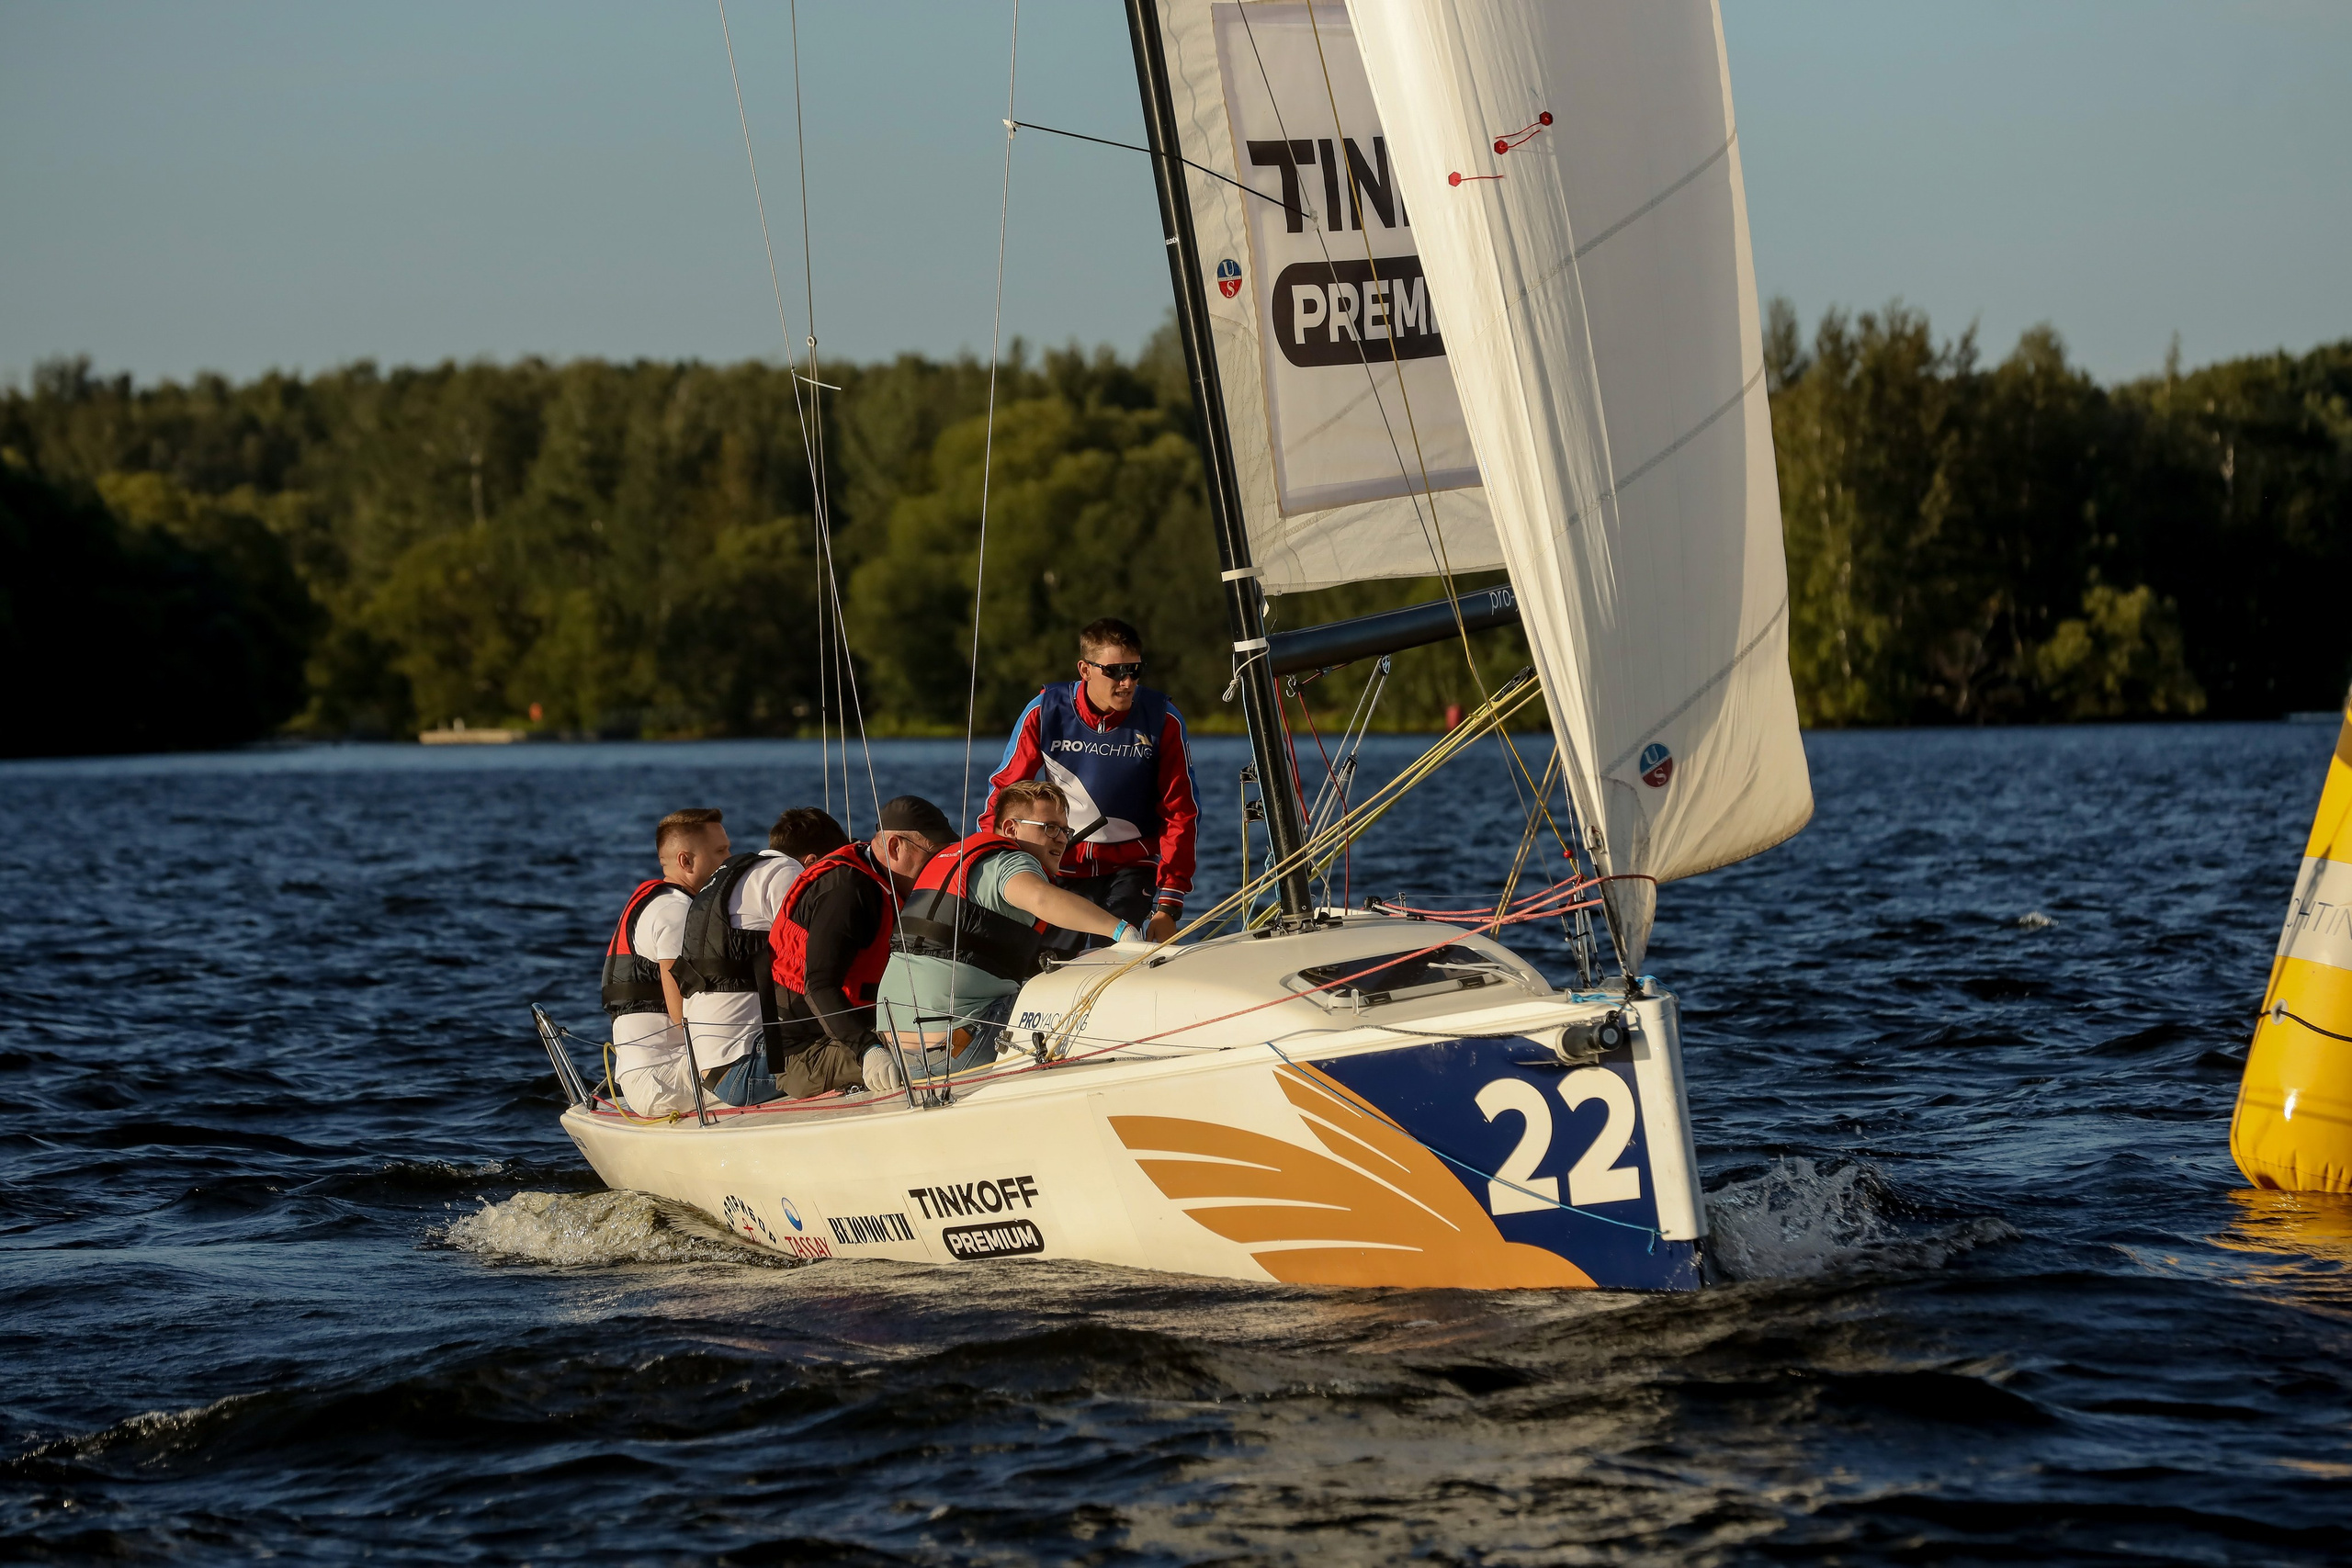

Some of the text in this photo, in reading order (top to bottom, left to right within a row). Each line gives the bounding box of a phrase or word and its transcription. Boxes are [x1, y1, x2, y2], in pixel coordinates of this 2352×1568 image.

[1246, 136, 1410, 233] TIN
[1488, 589, 1519, 615] pro-
[1050, 739, 1153, 759] PROYACHTING
[1473, 1066, 1641, 1216] 22
[908, 1175, 1039, 1220] TINKOFF
[827, 1213, 916, 1247] ВЕДОМОСТИ
[947, 1225, 1039, 1255] PREMIUM
[784, 1235, 832, 1258] TASSAY
